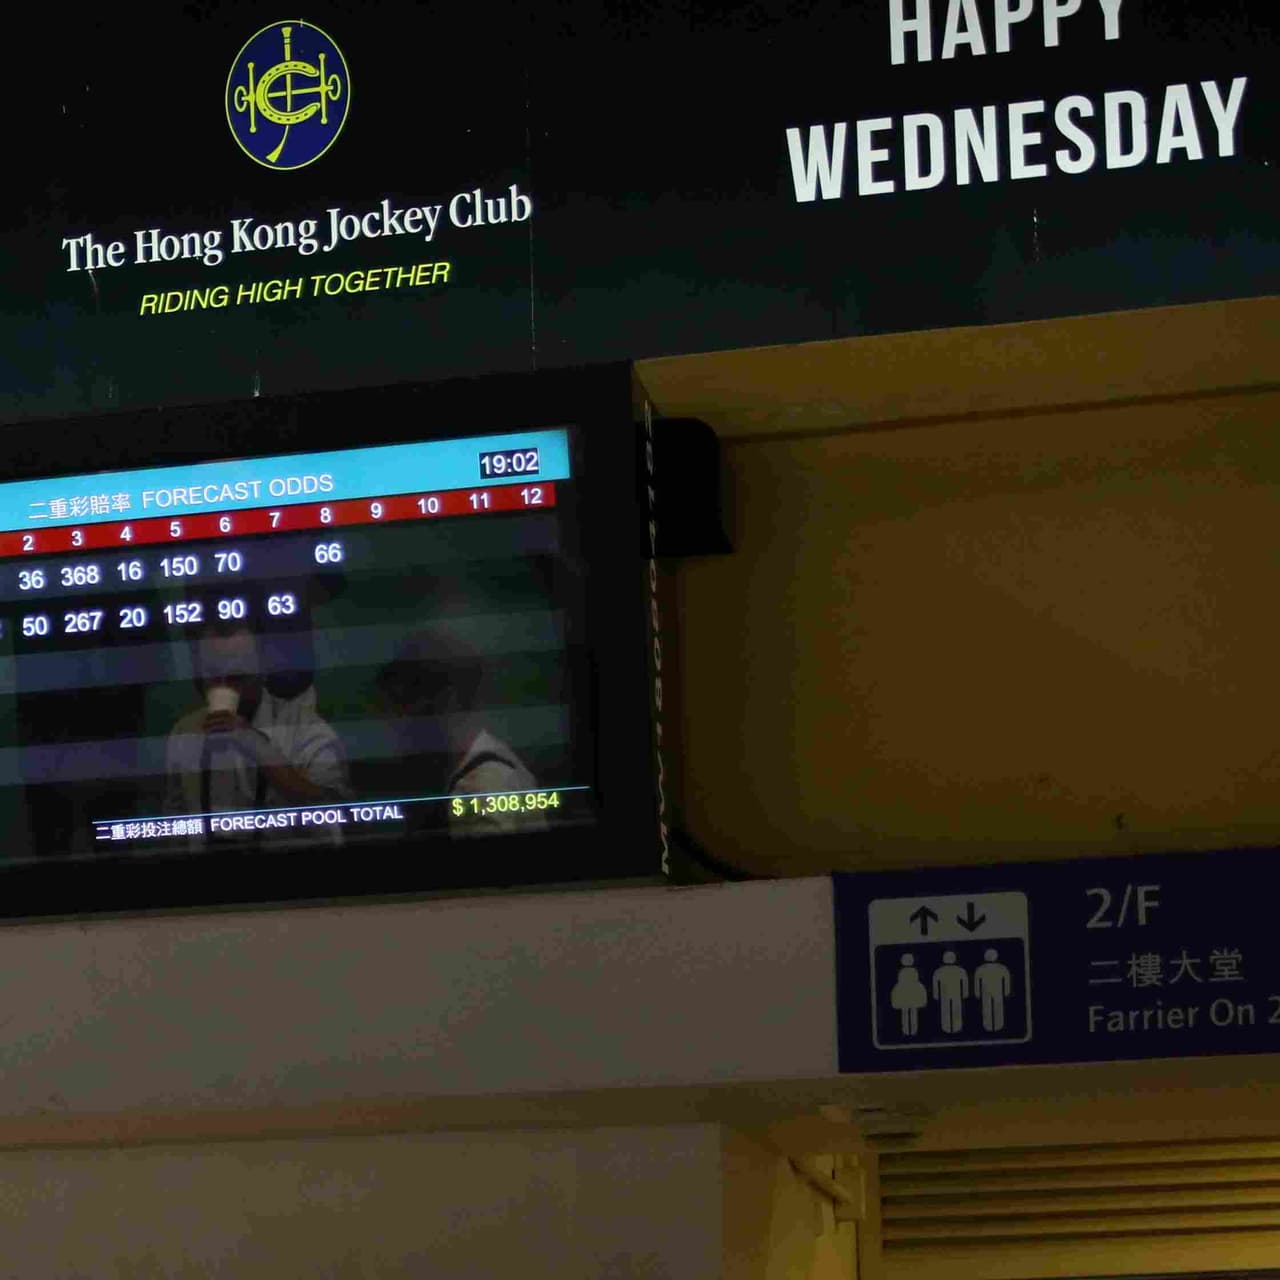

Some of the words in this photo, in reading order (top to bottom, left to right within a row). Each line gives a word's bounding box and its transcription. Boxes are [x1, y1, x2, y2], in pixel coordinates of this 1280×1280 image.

[786, 77, 1247, 202] WEDNESDAY
[62, 233, 125, 274] The
[134, 229, 223, 266] Hong
[230, 218, 318, 255] Kong
[323, 199, 442, 252] Jockey
[449, 184, 532, 228] Club
[140, 286, 229, 315] RIDING
[236, 278, 303, 305] HIGH
[311, 262, 450, 296] TOGETHER
[28, 492, 131, 519] 二重彩賠率
[142, 480, 262, 509] FORECAST
[269, 474, 334, 496] ODDS
[481, 449, 541, 474] 19:02
[61, 565, 100, 586] 368
[210, 812, 297, 832] FORECAST
[301, 809, 347, 825] POOL
[350, 805, 403, 821] TOTAL
[450, 796, 465, 816] $
[468, 790, 559, 813] 1,308,954
[1086, 884, 1160, 928] 2/F
[1089, 948, 1244, 988] 二樓大堂
[1088, 1001, 1199, 1032] Farrier
[1210, 999, 1255, 1026] On
